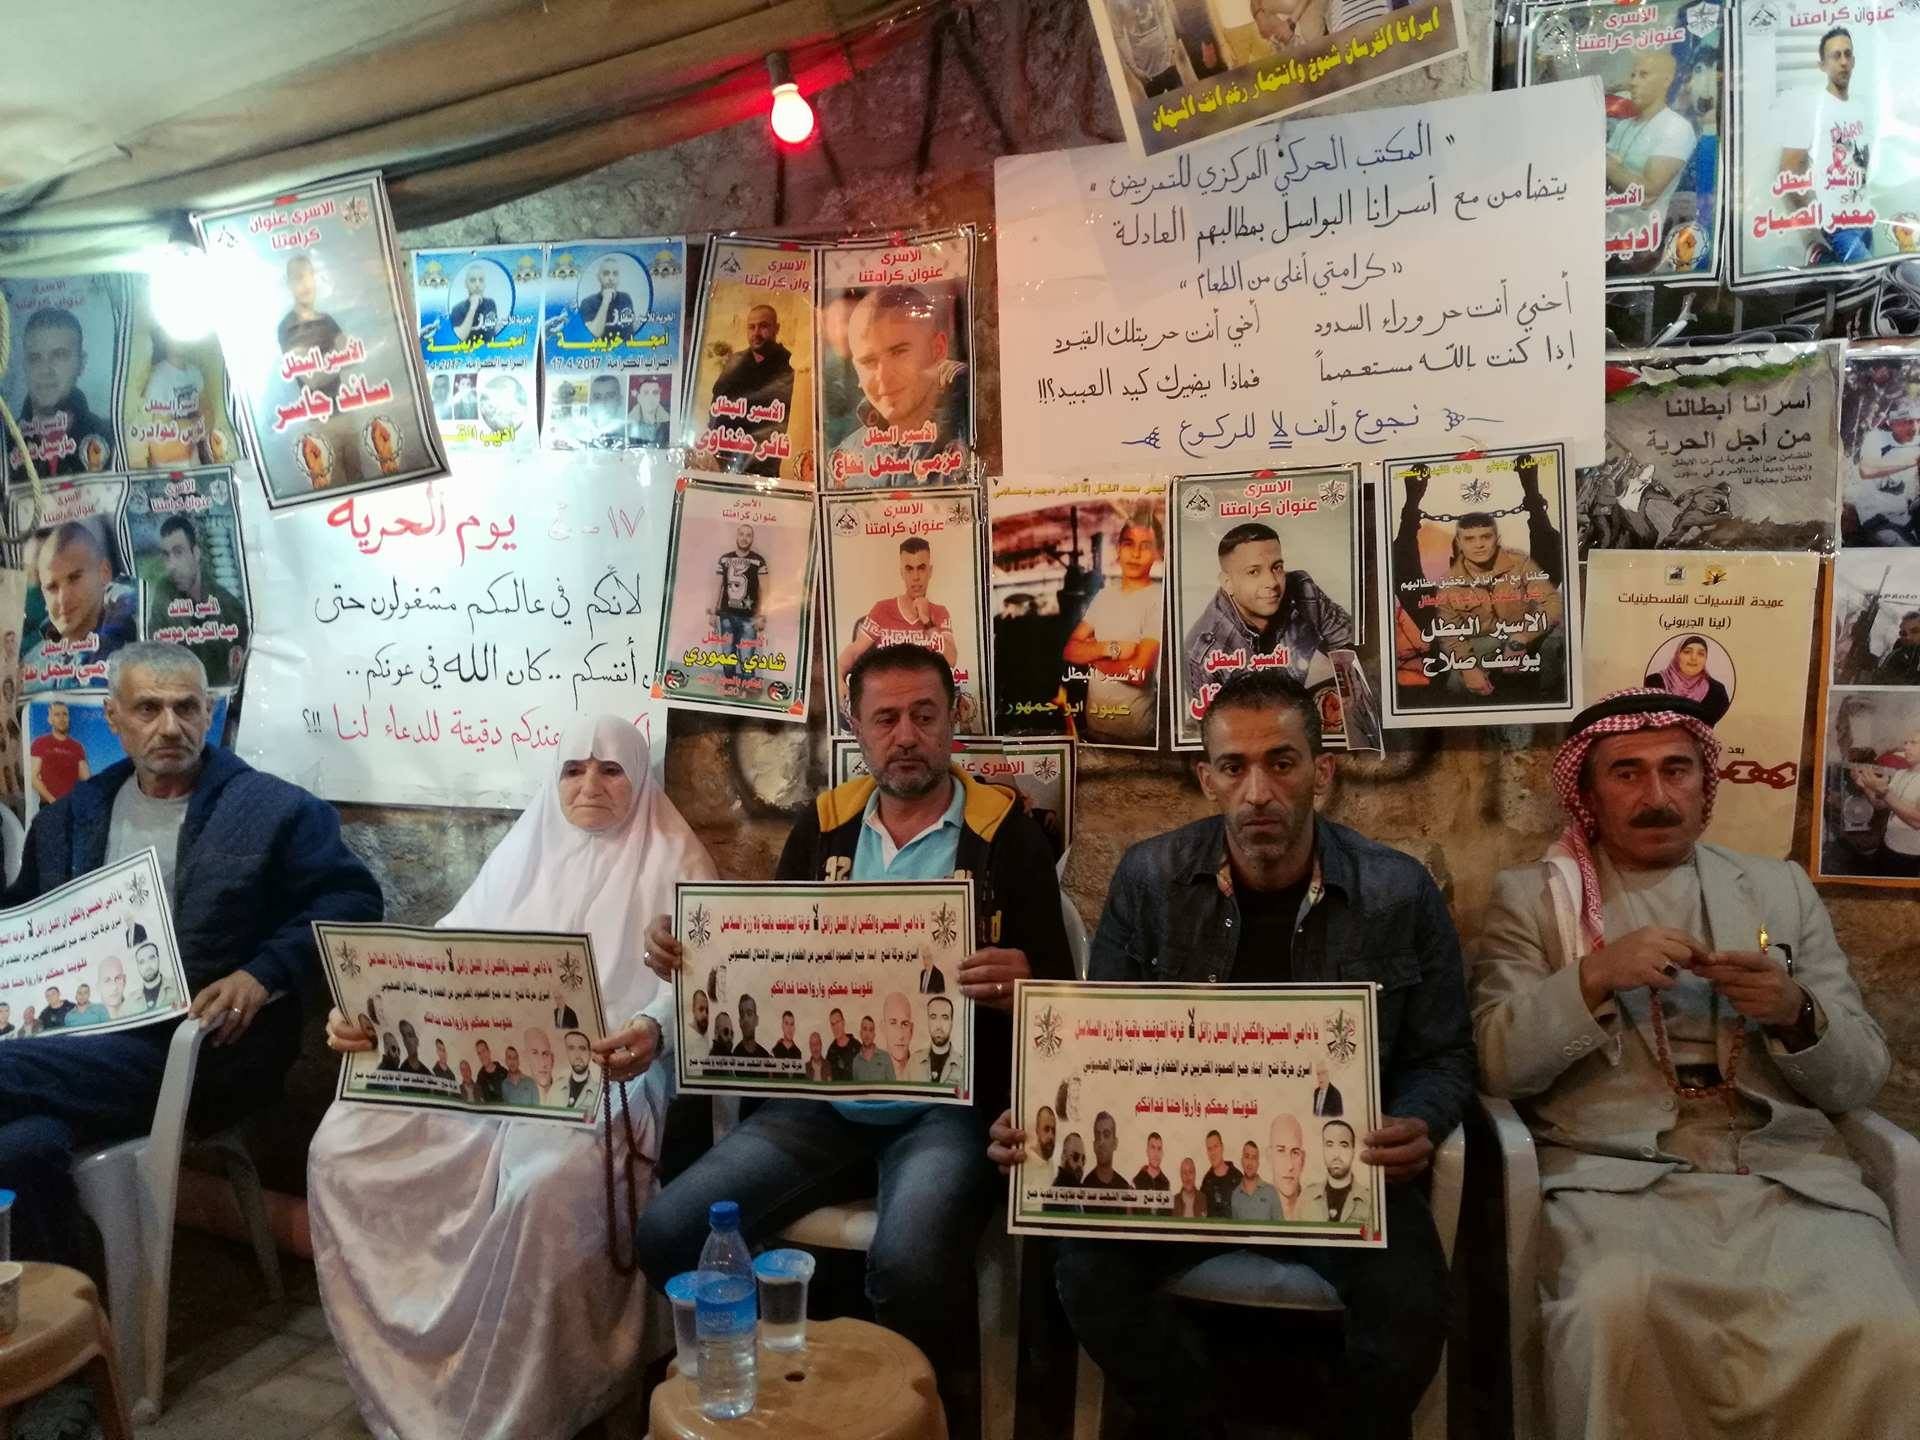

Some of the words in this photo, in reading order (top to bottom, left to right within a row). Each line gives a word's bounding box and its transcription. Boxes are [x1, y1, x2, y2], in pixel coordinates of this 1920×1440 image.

[1790, 6, 1850, 27] كرامتنا
[1854, 7, 1895, 25] عنوان
[1345, 26, 1393, 64] الفرسان
[1576, 32, 1633, 53] كرامتنا
[1637, 28, 1685, 50] عنوان
[1252, 58, 1305, 99] وانتصار
[1308, 45, 1341, 83] شموخ
[1152, 90, 1197, 133] السجان
[1225, 84, 1248, 111] رغم
[1357, 122, 1432, 174] المكتب
[1109, 153, 1191, 205] للتمريض
[1197, 143, 1267, 198] المركزي
[1487, 164, 1568, 209] يتضامن
[1271, 189, 1352, 244] البواسل
[1454, 193, 1480, 221] مع
[1753, 203, 1822, 238] الصباح
[1823, 209, 1876, 233] معمر
[250, 213, 288, 233] عنوان
[1113, 204, 1186, 247] العادلة
[1196, 204, 1264, 263] بمطالبهم
[744, 273, 787, 289] كرامتنا
[858, 269, 904, 285] كرامتنا
[908, 266, 943, 285] عنوان
[1197, 260, 1243, 300] الطعام
[1247, 274, 1271, 292] من
[1313, 253, 1385, 297] كرامتي
[1314, 302, 1371, 336] السدود
[1382, 299, 1423, 333] وراء
[1422, 307, 1463, 335] حر
[1053, 321, 1104, 354] القيود
[1107, 317, 1148, 348] بتلك
[1142, 329, 1180, 351] حر
[282, 347, 321, 379] البطل
[1486, 336, 1531, 367] كنت
[1546, 330, 1575, 370] إذا
[1122, 367, 1150, 402] كيد
[1156, 363, 1212, 399] يضيرك
[1223, 363, 1261, 389] فماذا
[274, 386, 331, 432] جاسر
[711, 396, 747, 419] البطل
[864, 425, 898, 448] البطل
[1179, 412, 1256, 459] للركوع
[1268, 410, 1293, 447] لا
[1355, 403, 1420, 444] نجوع
[1726, 423, 1767, 452] أجل
[1646, 430, 1715, 456] الحرية
[1777, 429, 1811, 450] من
[869, 453, 912, 478] سهل
[914, 452, 961, 480] عزمي
[1220, 502, 1272, 518] كرامتنا
[1277, 501, 1318, 518] عنوان
[456, 513, 518, 567] يوم
[865, 522, 906, 536] كرامتنا
[909, 520, 944, 535] عنوان
[1400, 577, 1437, 592] مطالبهم
[1470, 578, 1481, 588] في
[1509, 574, 1521, 585] مع
[1525, 570, 1550, 581] كلنا
[315, 583, 366, 624] حتى
[370, 576, 457, 620] مشغولون
[467, 571, 545, 635] عالمكم
[551, 577, 571, 626] في
[1618, 593, 1688, 606] الفلسطينيات
[1750, 596, 1785, 608] عميدة
[1420, 616, 1480, 642] البطل
[420, 645, 442, 689] في
[444, 641, 497, 685] الله
[683, 647, 738, 667] عموري
[742, 652, 786, 674] شادي
[1205, 650, 1244, 672] البطل
[1422, 651, 1477, 677] صلاح
[1481, 648, 1541, 672] يوسف
[571, 636, 636, 711] أنفسكم
[333, 703, 369, 742] لنا
[1006, 700, 1058, 716] جمهور
[385, 704, 441, 745] للدعاء
[450, 711, 503, 752] دقيقة
